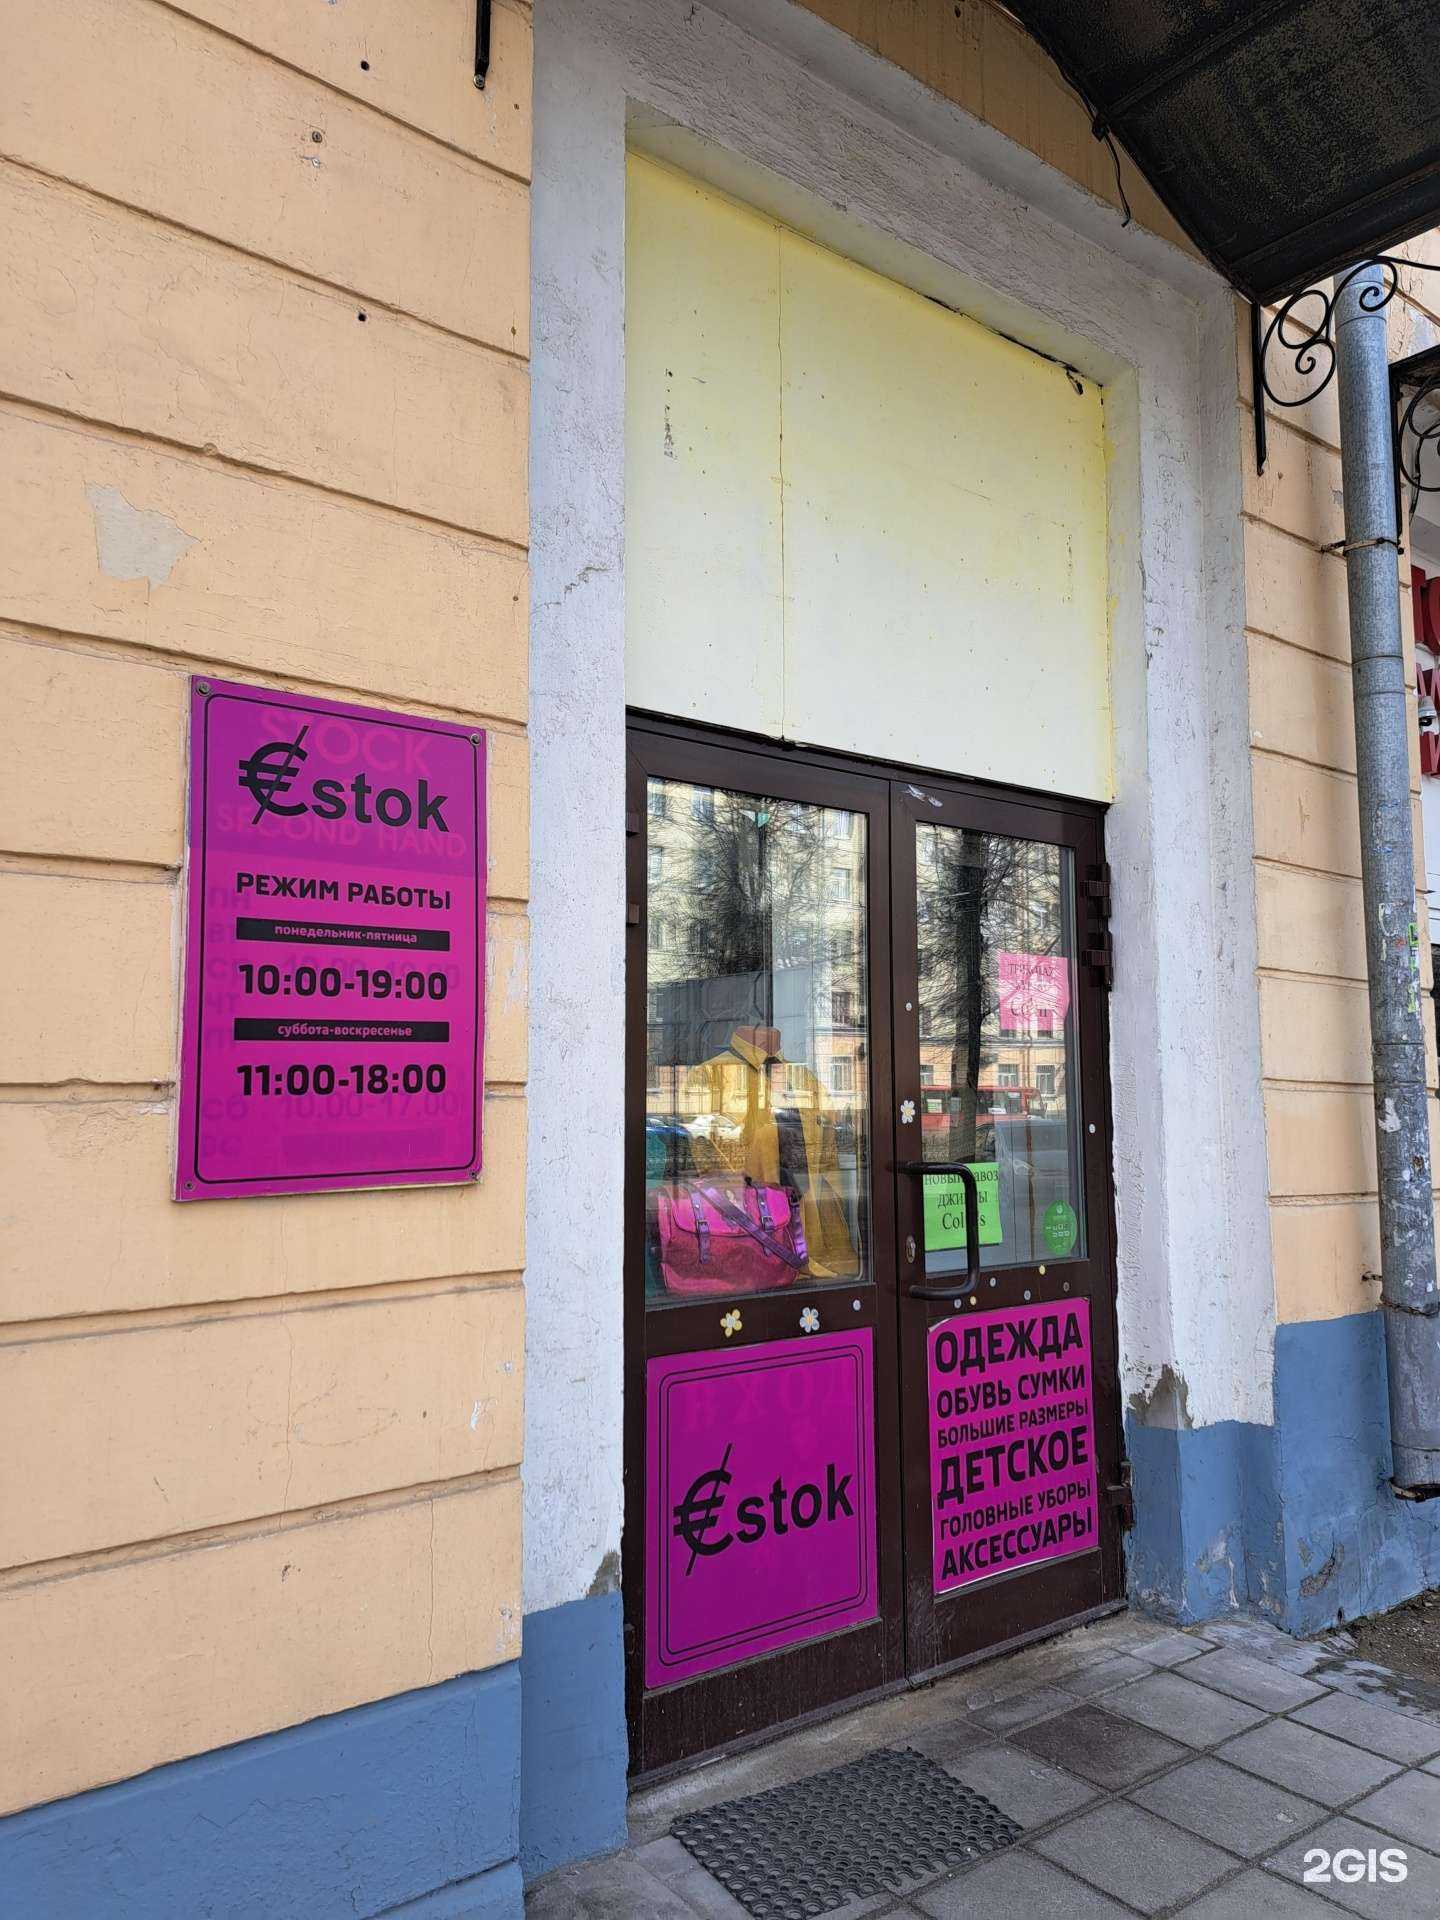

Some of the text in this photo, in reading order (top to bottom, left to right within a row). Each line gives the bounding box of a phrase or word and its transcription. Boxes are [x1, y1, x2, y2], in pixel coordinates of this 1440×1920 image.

[236, 872, 339, 901] РЕЖИМ
[347, 882, 451, 910] РАБОТЫ
[275, 924, 417, 945] понедельник-пятница
[239, 964, 447, 1000] 10:00-19:00
[278, 1023, 412, 1038] суббота-воскресенье
[237, 1064, 446, 1096] 11:00-18:00
[935, 1312, 1083, 1377] ОДЕЖДА
[937, 1364, 1086, 1419] ОБУВЬ СУМКИ
[938, 1398, 1089, 1449] БОЛЬШИЕ РАЗМЕРЫ
[937, 1425, 1089, 1509] ДЕТСКОЕ
[940, 1478, 1092, 1540] ГОЛОВНЫЕ УБОРЫ
[941, 1507, 1093, 1580] АКСЕССУАРЫ
